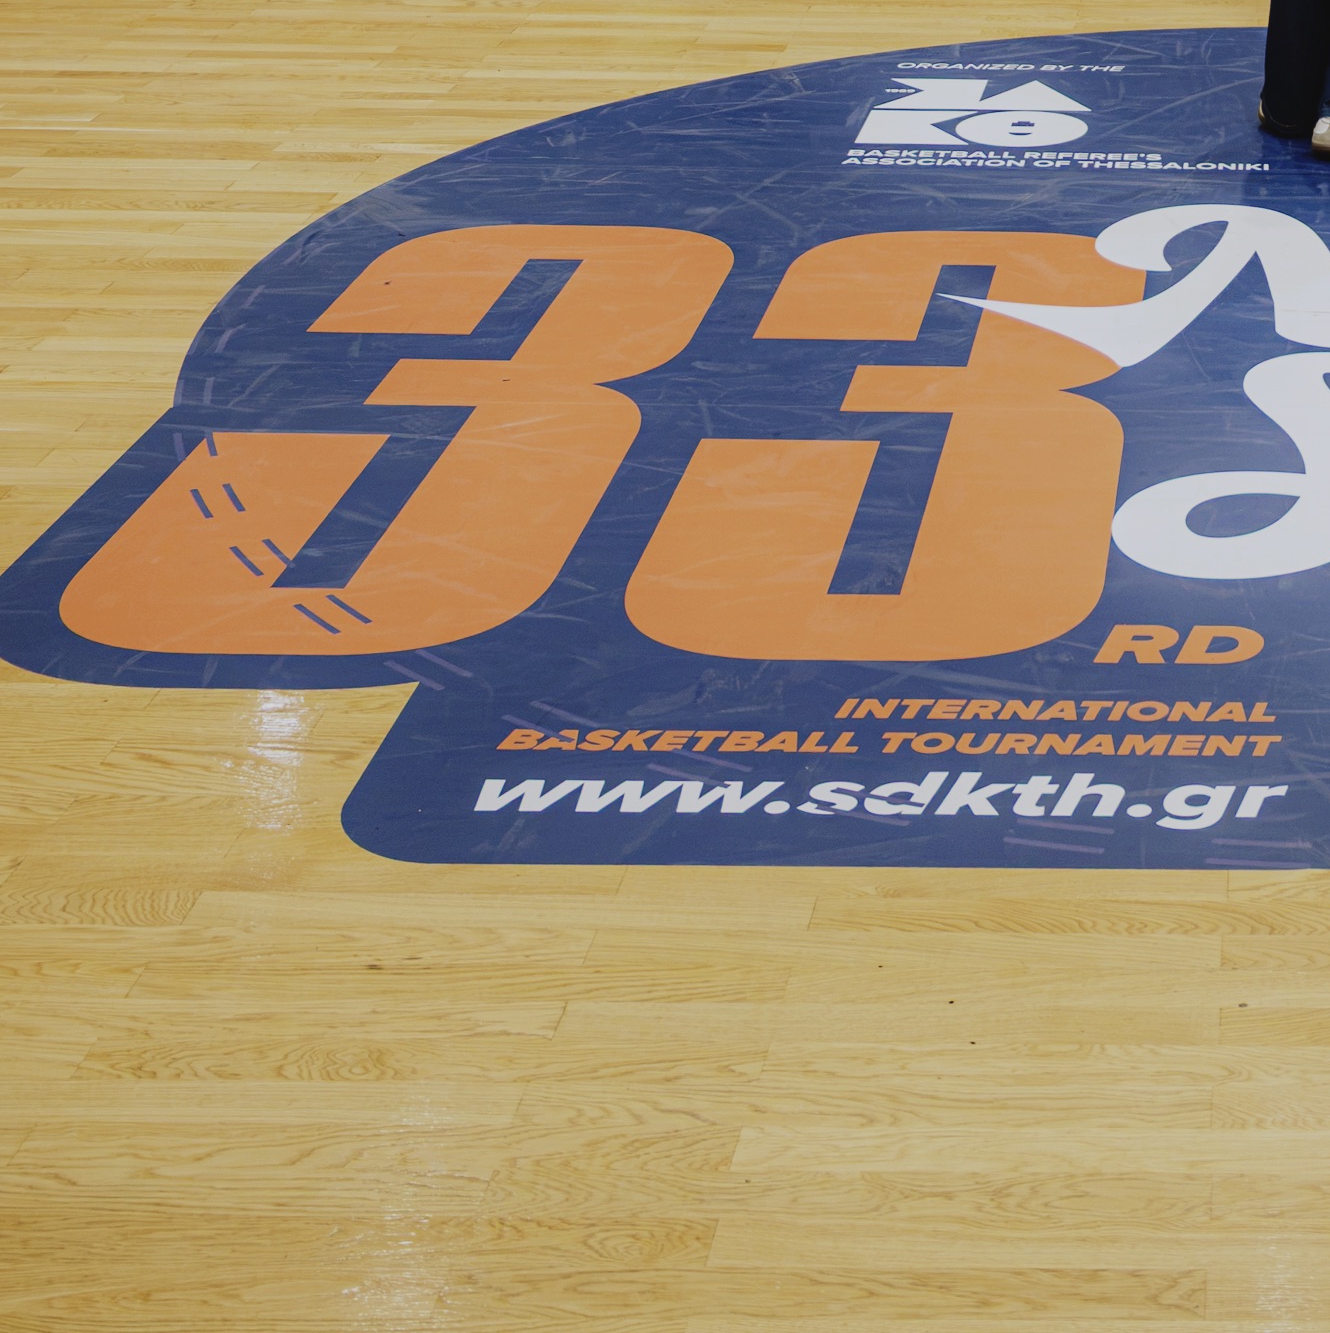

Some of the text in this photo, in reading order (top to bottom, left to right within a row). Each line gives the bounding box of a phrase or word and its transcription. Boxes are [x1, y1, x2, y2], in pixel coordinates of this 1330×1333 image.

[897, 63, 1126, 73] ORGANIZED BY THE
[841, 157, 1270, 171] ASSOCIATION OF THESSALONIKI
[847, 149, 1162, 161] BASKETBALL REFEREE'S
[58, 224, 1148, 663] 33
[1093, 623, 1267, 667] RD
[836, 697, 1277, 723] INTERNATIONAL
[496, 728, 1282, 757] BASKETBALL TOURNAMENT
[474, 773, 1288, 830] www.sdkth.gr
